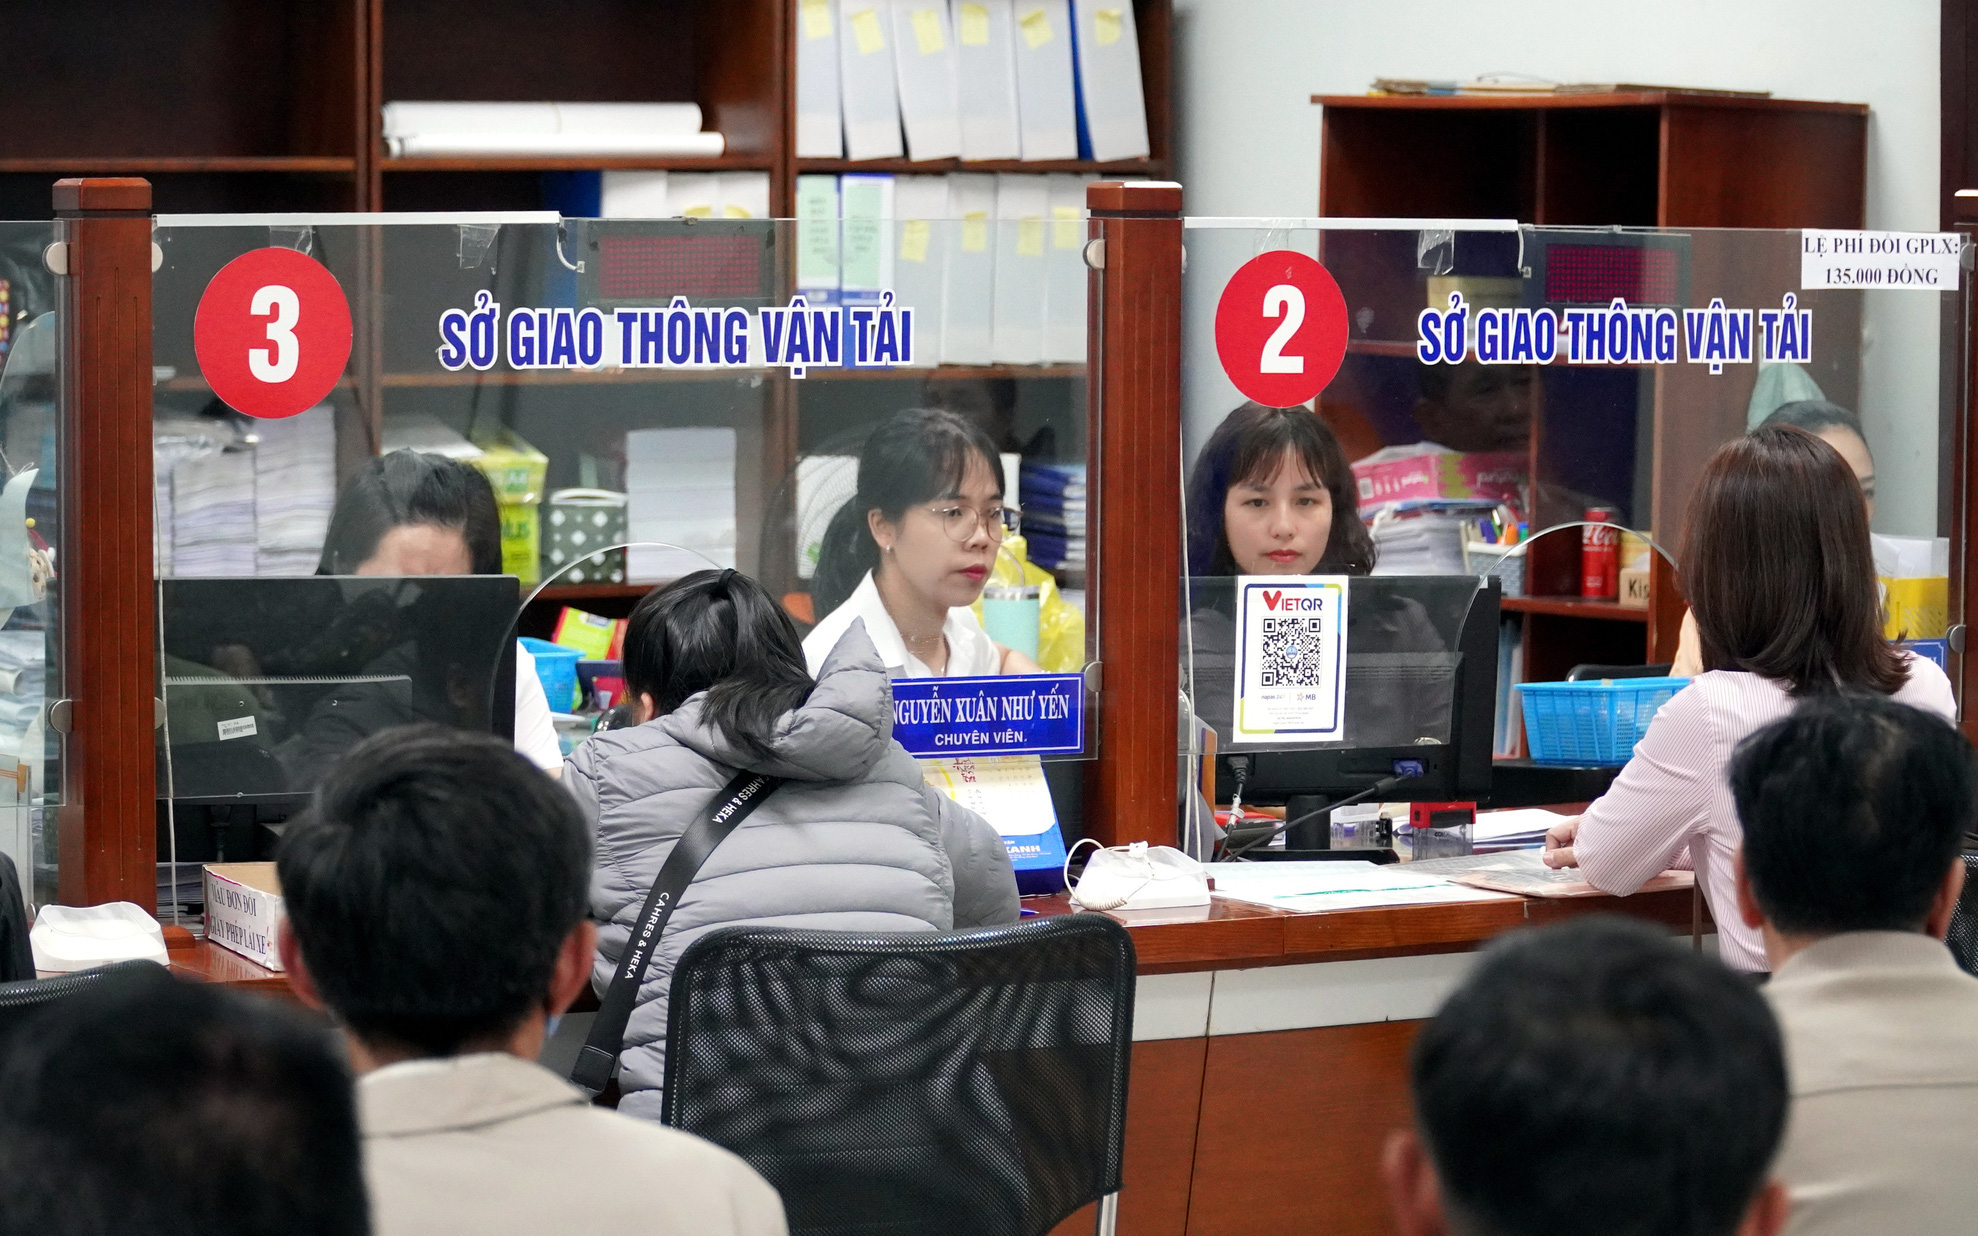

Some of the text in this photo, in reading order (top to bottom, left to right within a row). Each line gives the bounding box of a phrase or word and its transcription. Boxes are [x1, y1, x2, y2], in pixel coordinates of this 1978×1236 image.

[1804, 233, 1959, 258] LỆ PHÍ ĐỔI GPLX:
[1825, 263, 1938, 285] 135.000 ĐỒNG
[248, 284, 300, 384] 3
[440, 290, 913, 377] SỞ GIAO THÔNG VẬN TẢI
[1260, 284, 1306, 374] 2
[1418, 292, 1812, 373] SỞ GIAO THÔNG VẬN TẢI
[1262, 590, 1323, 611] VIETQR
[892, 683, 1070, 726] NGUYỄN XUÂN NHƯ YẾN
[1305, 693, 1317, 701] MB
[934, 728, 1024, 747] CHUYÊN VIÊN
[712, 803, 737, 823] HEKA
[731, 797, 743, 806] &
[256, 933, 267, 955] XE
[624, 892, 670, 979] CAHRES & HEKA
